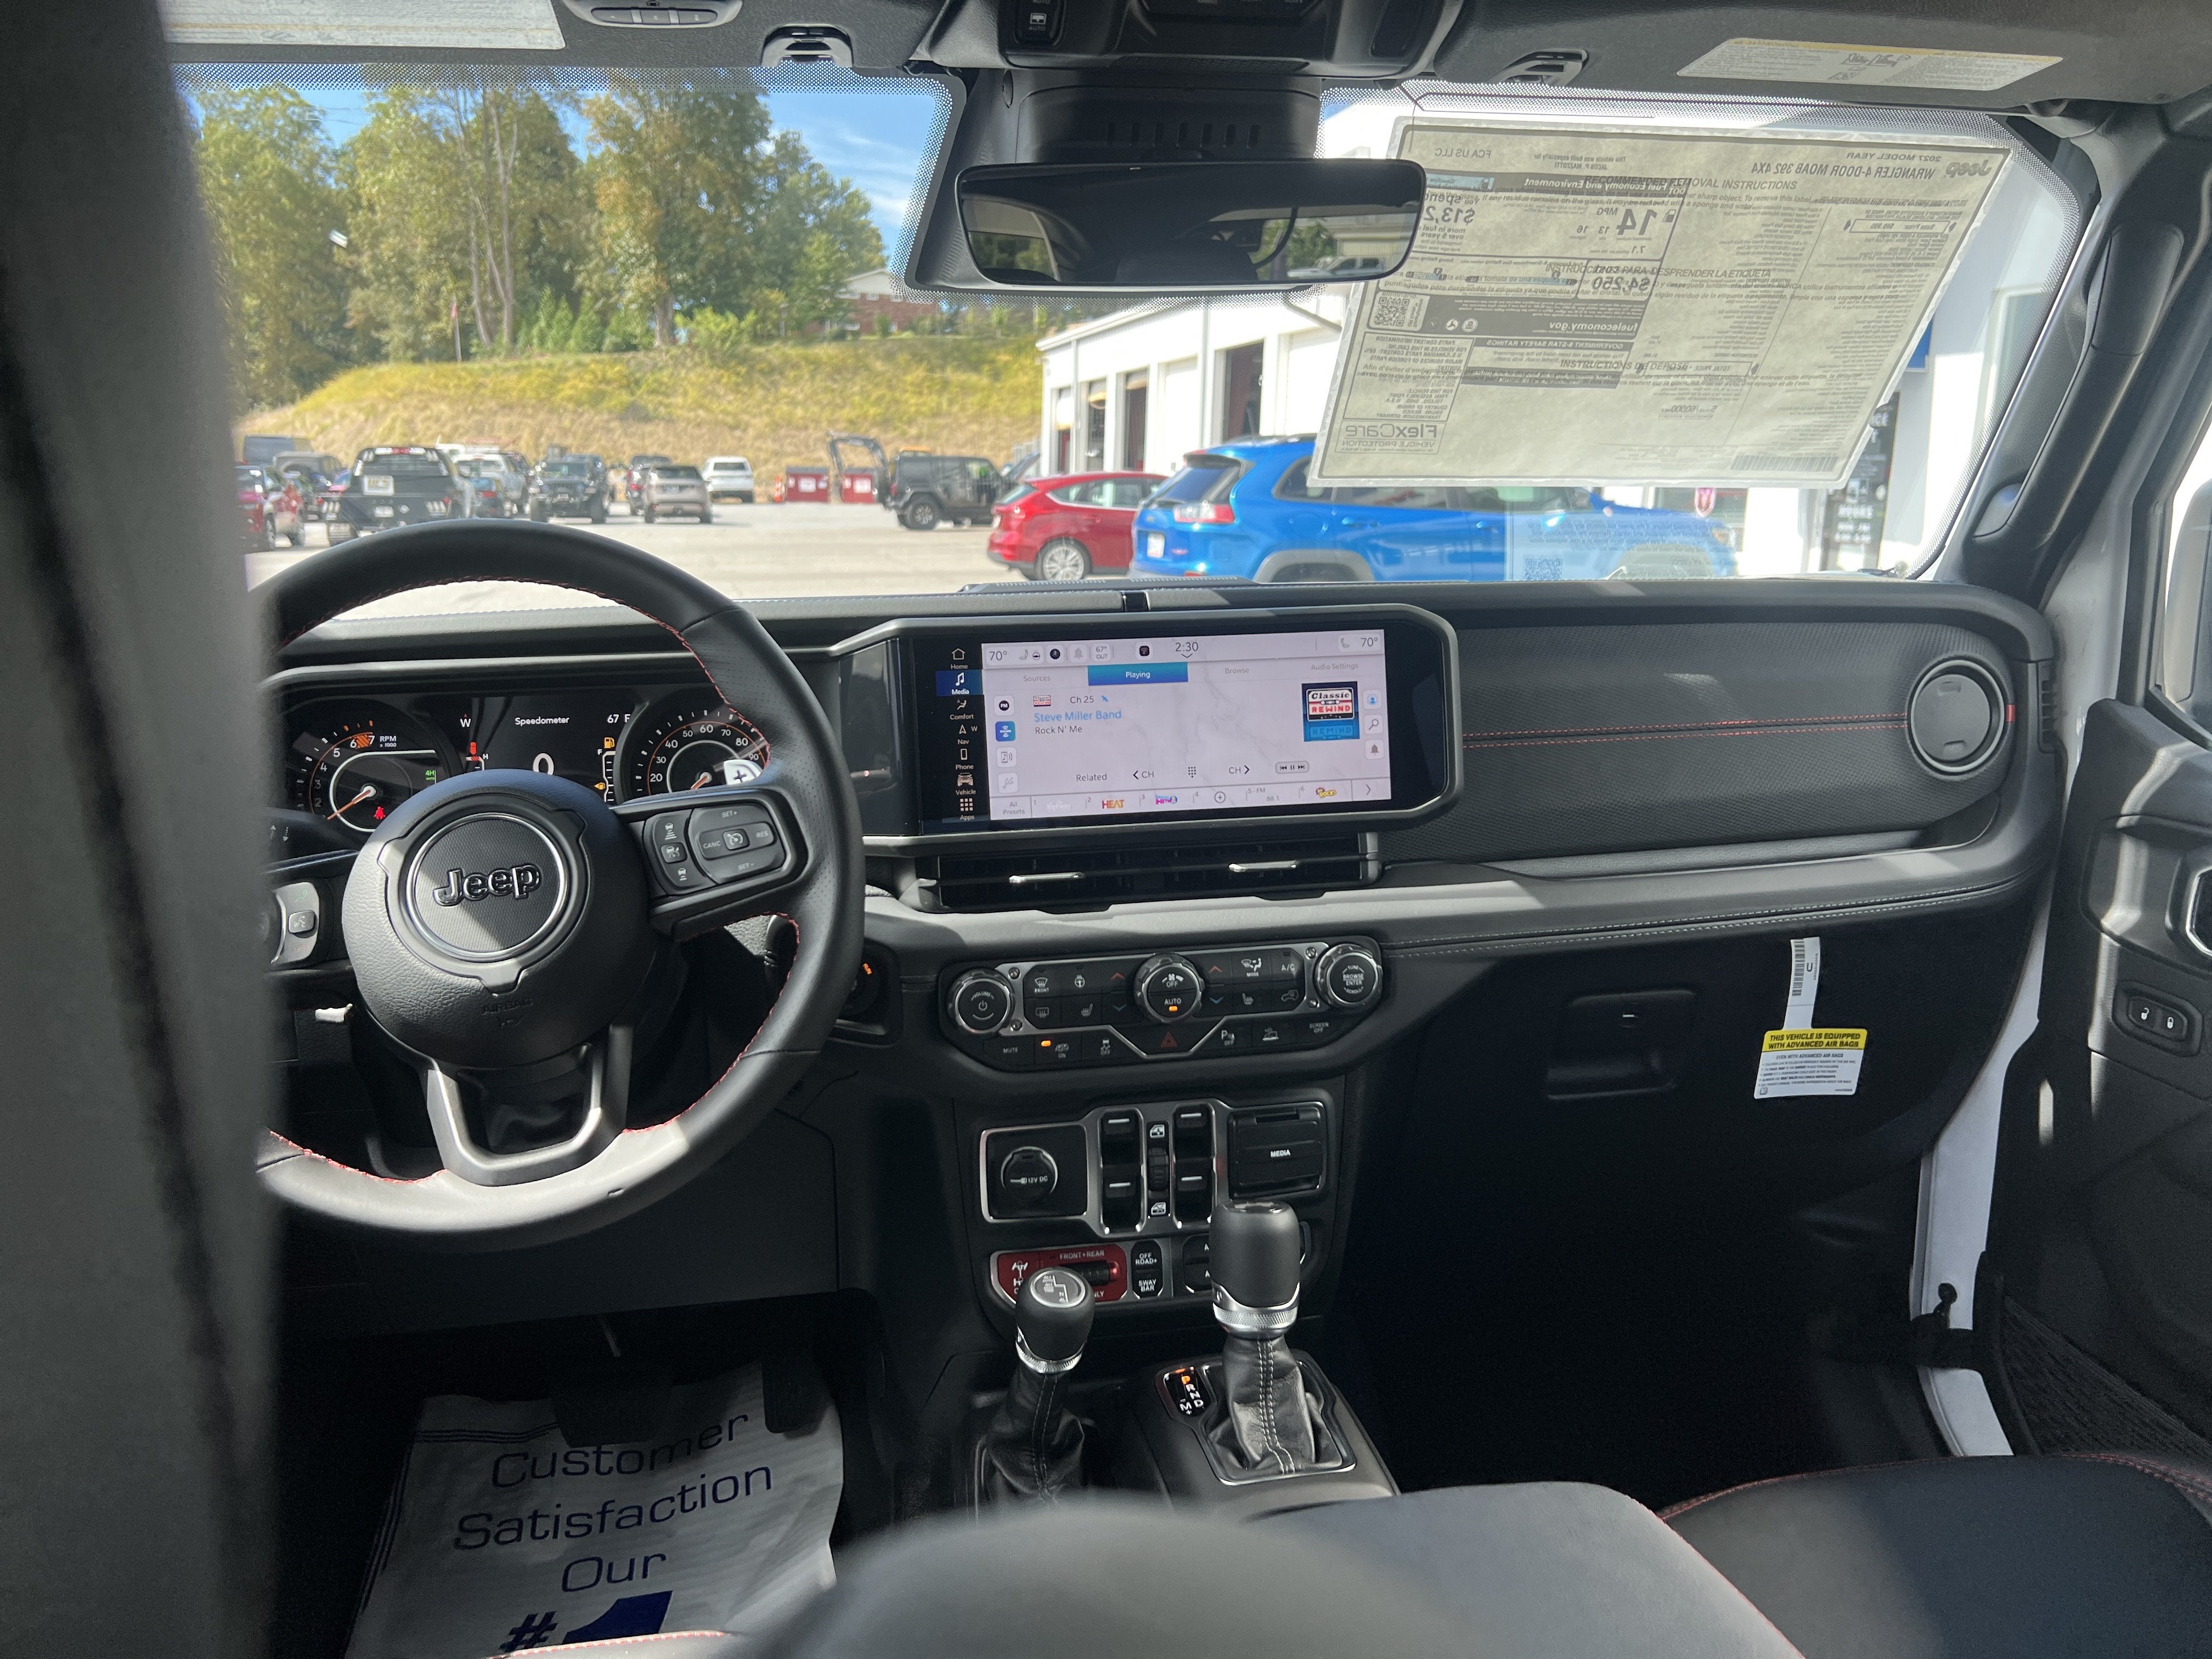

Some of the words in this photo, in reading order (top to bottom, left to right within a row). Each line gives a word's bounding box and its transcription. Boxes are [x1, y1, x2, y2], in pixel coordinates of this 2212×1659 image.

[1722, 179, 1798, 190] INSTRUCTIONS
[1650, 268, 1713, 278] DESPRENDER
[1714, 269, 1728, 278] LA
[1728, 269, 1771, 279] ETIQUETA
[1175, 642, 1199, 652] 2:30
[1361, 637, 1378, 647] 70°
[989, 651, 1007, 661] 70°
[1125, 670, 1150, 680] Playing
[1331, 662, 1359, 672] Settings
[1311, 691, 1350, 700] Classic
[1312, 704, 1351, 713] REWIND
[515, 715, 570, 726] Speedometer
[607, 714, 619, 724] 67
[624, 714, 631, 723] F
[1034, 712, 1063, 723] Steve
[1065, 710, 1094, 721] Miller
[1096, 709, 1122, 720] Band
[460, 718, 471, 727] W
[682, 729, 693, 738] 50
[699, 724, 714, 734] 60
[721, 729, 731, 737] 70
[1035, 725, 1056, 735] Rock
[1069, 725, 1082, 733] Me
[350, 740, 357, 749] 6
[368, 735, 375, 745] 7
[664, 739, 678, 749] 40
[735, 737, 748, 747] 80
[333, 747, 341, 758] 5
[533, 752, 554, 775] 0
[656, 755, 667, 764] 30
[320, 762, 328, 772] 4
[650, 772, 663, 782] 20
[1076, 773, 1108, 782] Related
[1141, 771, 1154, 779] CH
[1228, 766, 1242, 775] CH
[1102, 799, 1125, 809] HEAT
[703, 840, 721, 849] CANC
[433, 862, 540, 907] Jeep
[1281, 963, 1295, 971] A/C
[1270, 1149, 1291, 1158] MEDIA
[1138, 1278, 1157, 1287] SWAY
[1181, 1375, 1191, 1385] P
[1186, 1383, 1196, 1392] R
[1189, 1390, 1201, 1400] N
[1179, 1402, 1192, 1412] M
[1193, 1398, 1204, 1408] D
[492, 1412, 750, 1489] Customer
[453, 1466, 772, 1551] Satisfaction
[561, 1551, 667, 1593] Our
